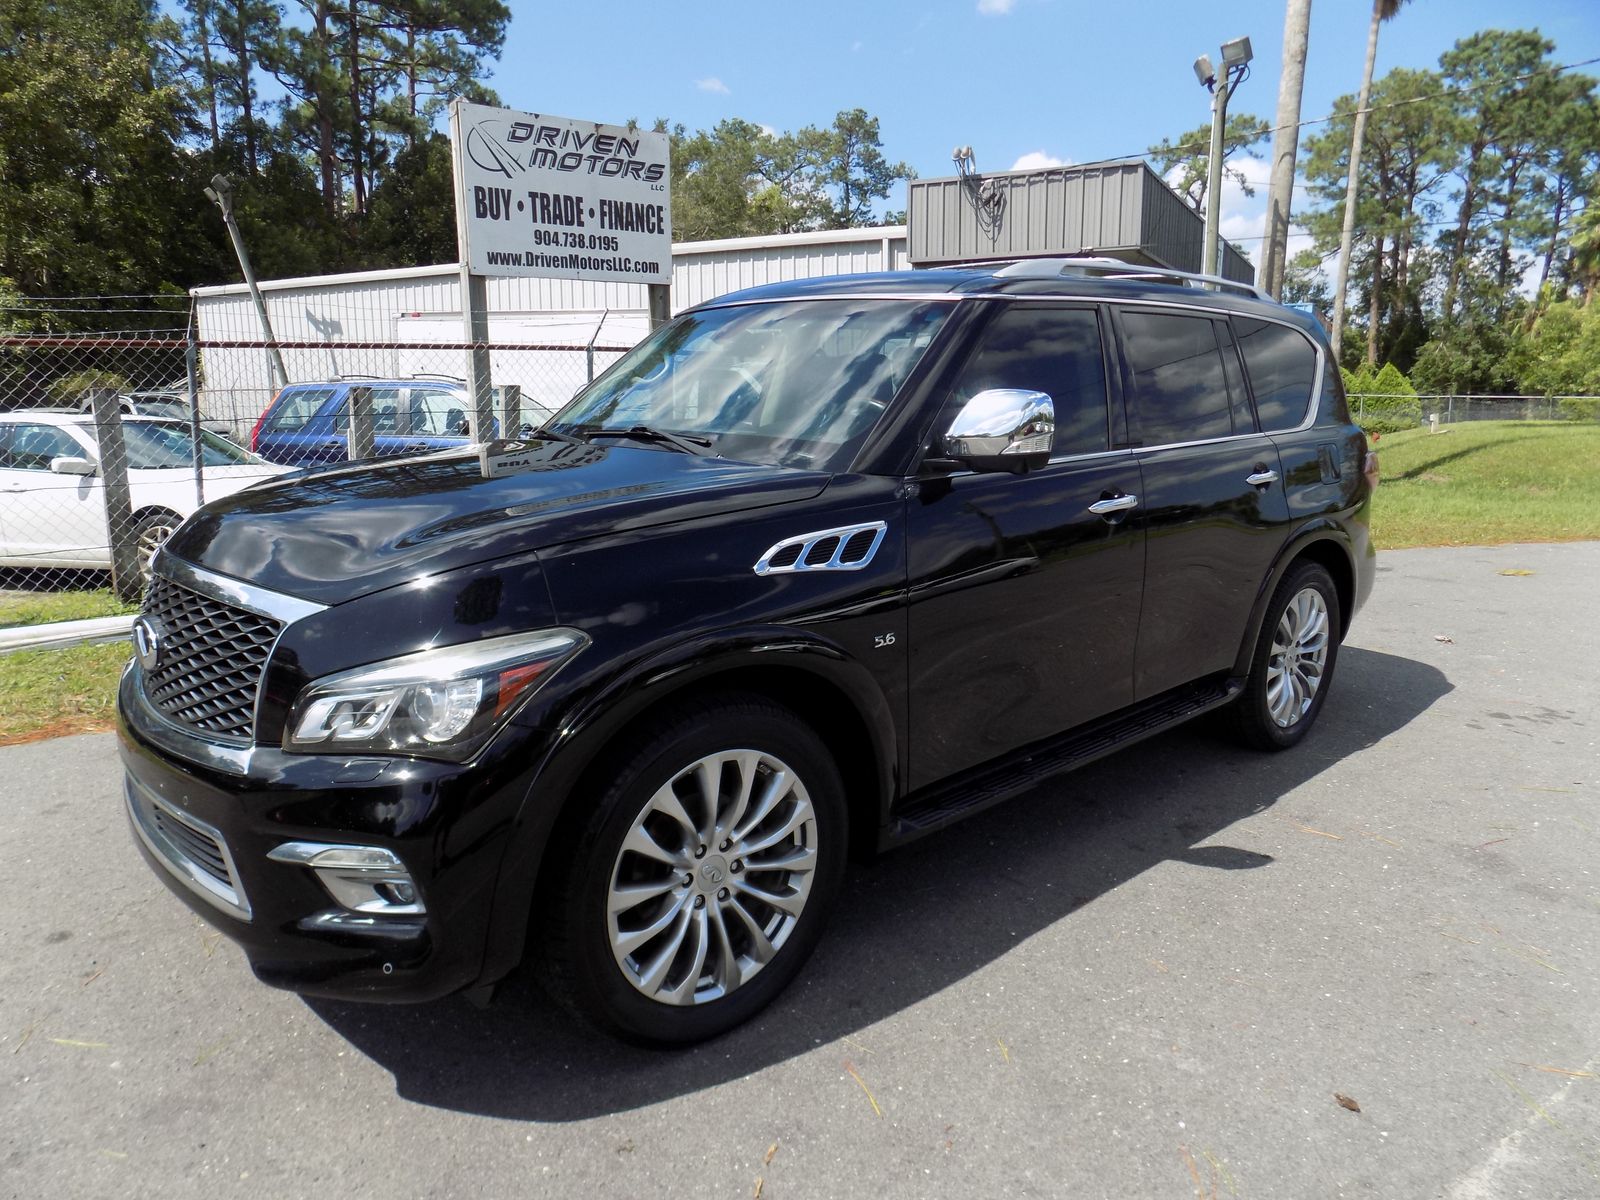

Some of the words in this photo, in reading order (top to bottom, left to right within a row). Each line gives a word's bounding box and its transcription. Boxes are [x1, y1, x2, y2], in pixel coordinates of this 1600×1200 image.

[507, 122, 639, 158] DRIVEN
[529, 148, 666, 182] MOTORS
[650, 184, 665, 192] LLC
[474, 185, 512, 221] BUY
[528, 191, 585, 228] TRADE
[599, 199, 665, 235] FINANCE
[534, 229, 619, 252] 904.738.0195
[487, 251, 660, 274] www.DrivenMotorsLLC.com
